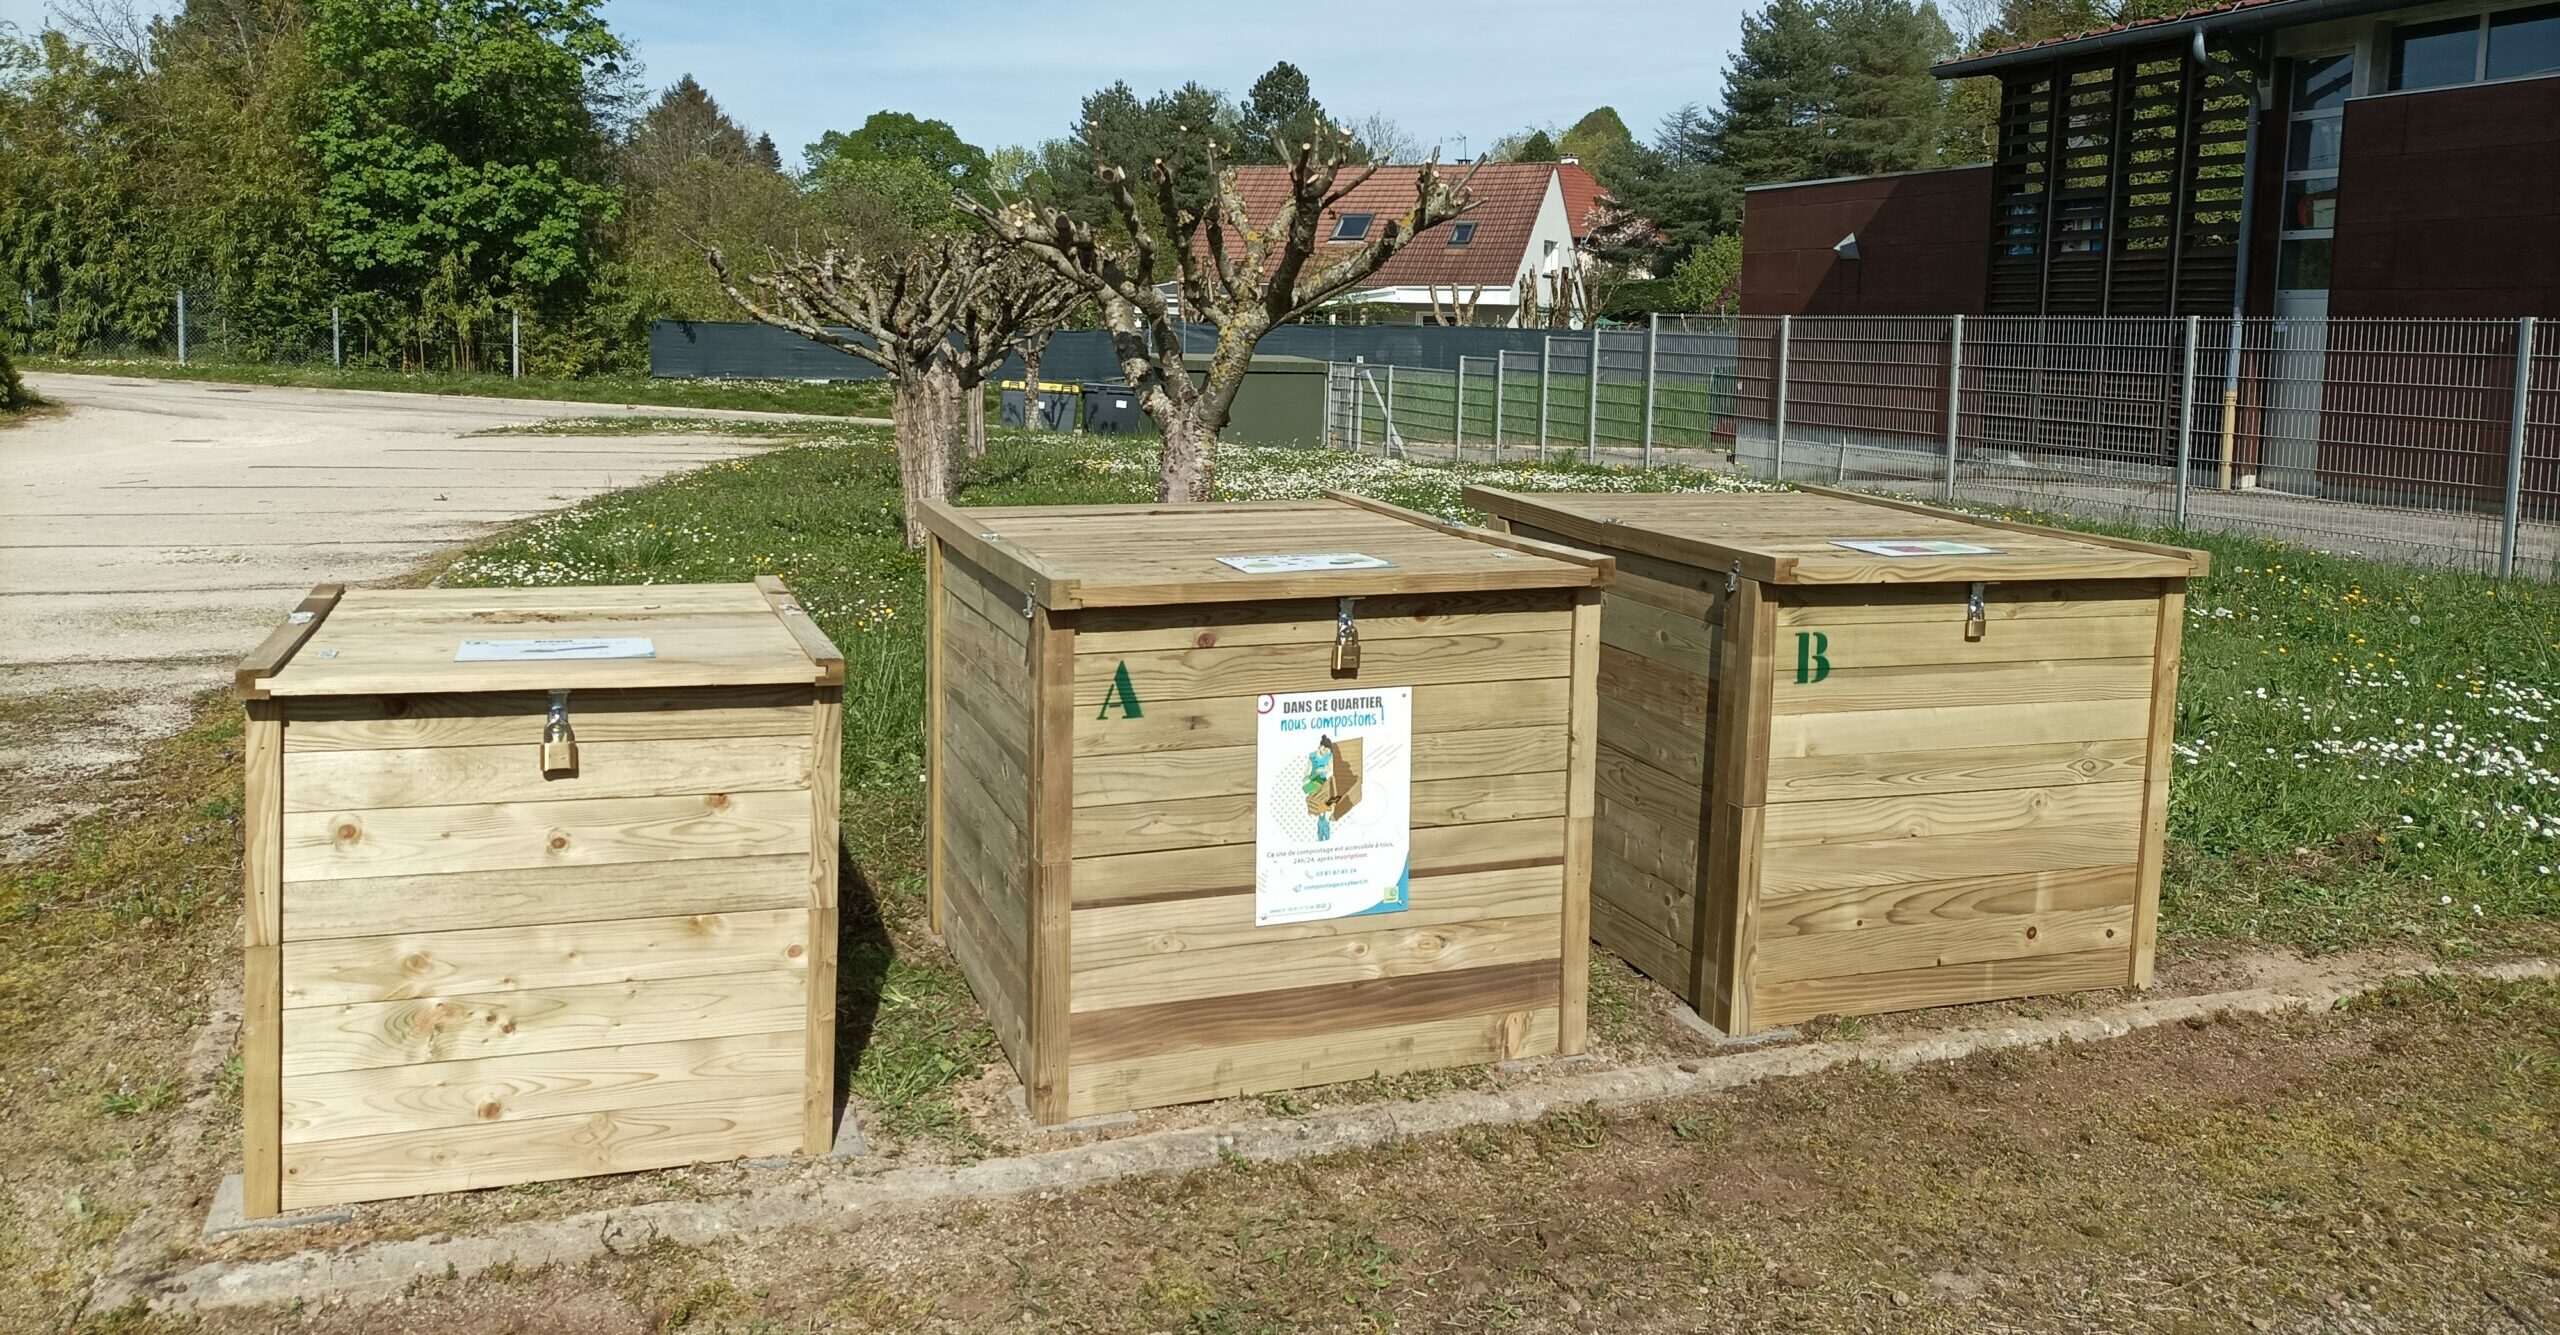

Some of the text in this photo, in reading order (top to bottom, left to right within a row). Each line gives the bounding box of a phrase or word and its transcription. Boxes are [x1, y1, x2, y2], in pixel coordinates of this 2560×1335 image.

[1793, 632, 1831, 685] B
[1096, 659, 1144, 720] A
[1283, 696, 1382, 713] DANS CE QUARTIER
[1280, 718, 1307, 731] nous
[1310, 711, 1377, 737] compostons
[1276, 850, 1286, 858] site
[1297, 847, 1333, 856] compostage
[1344, 842, 1374, 851] accessible
